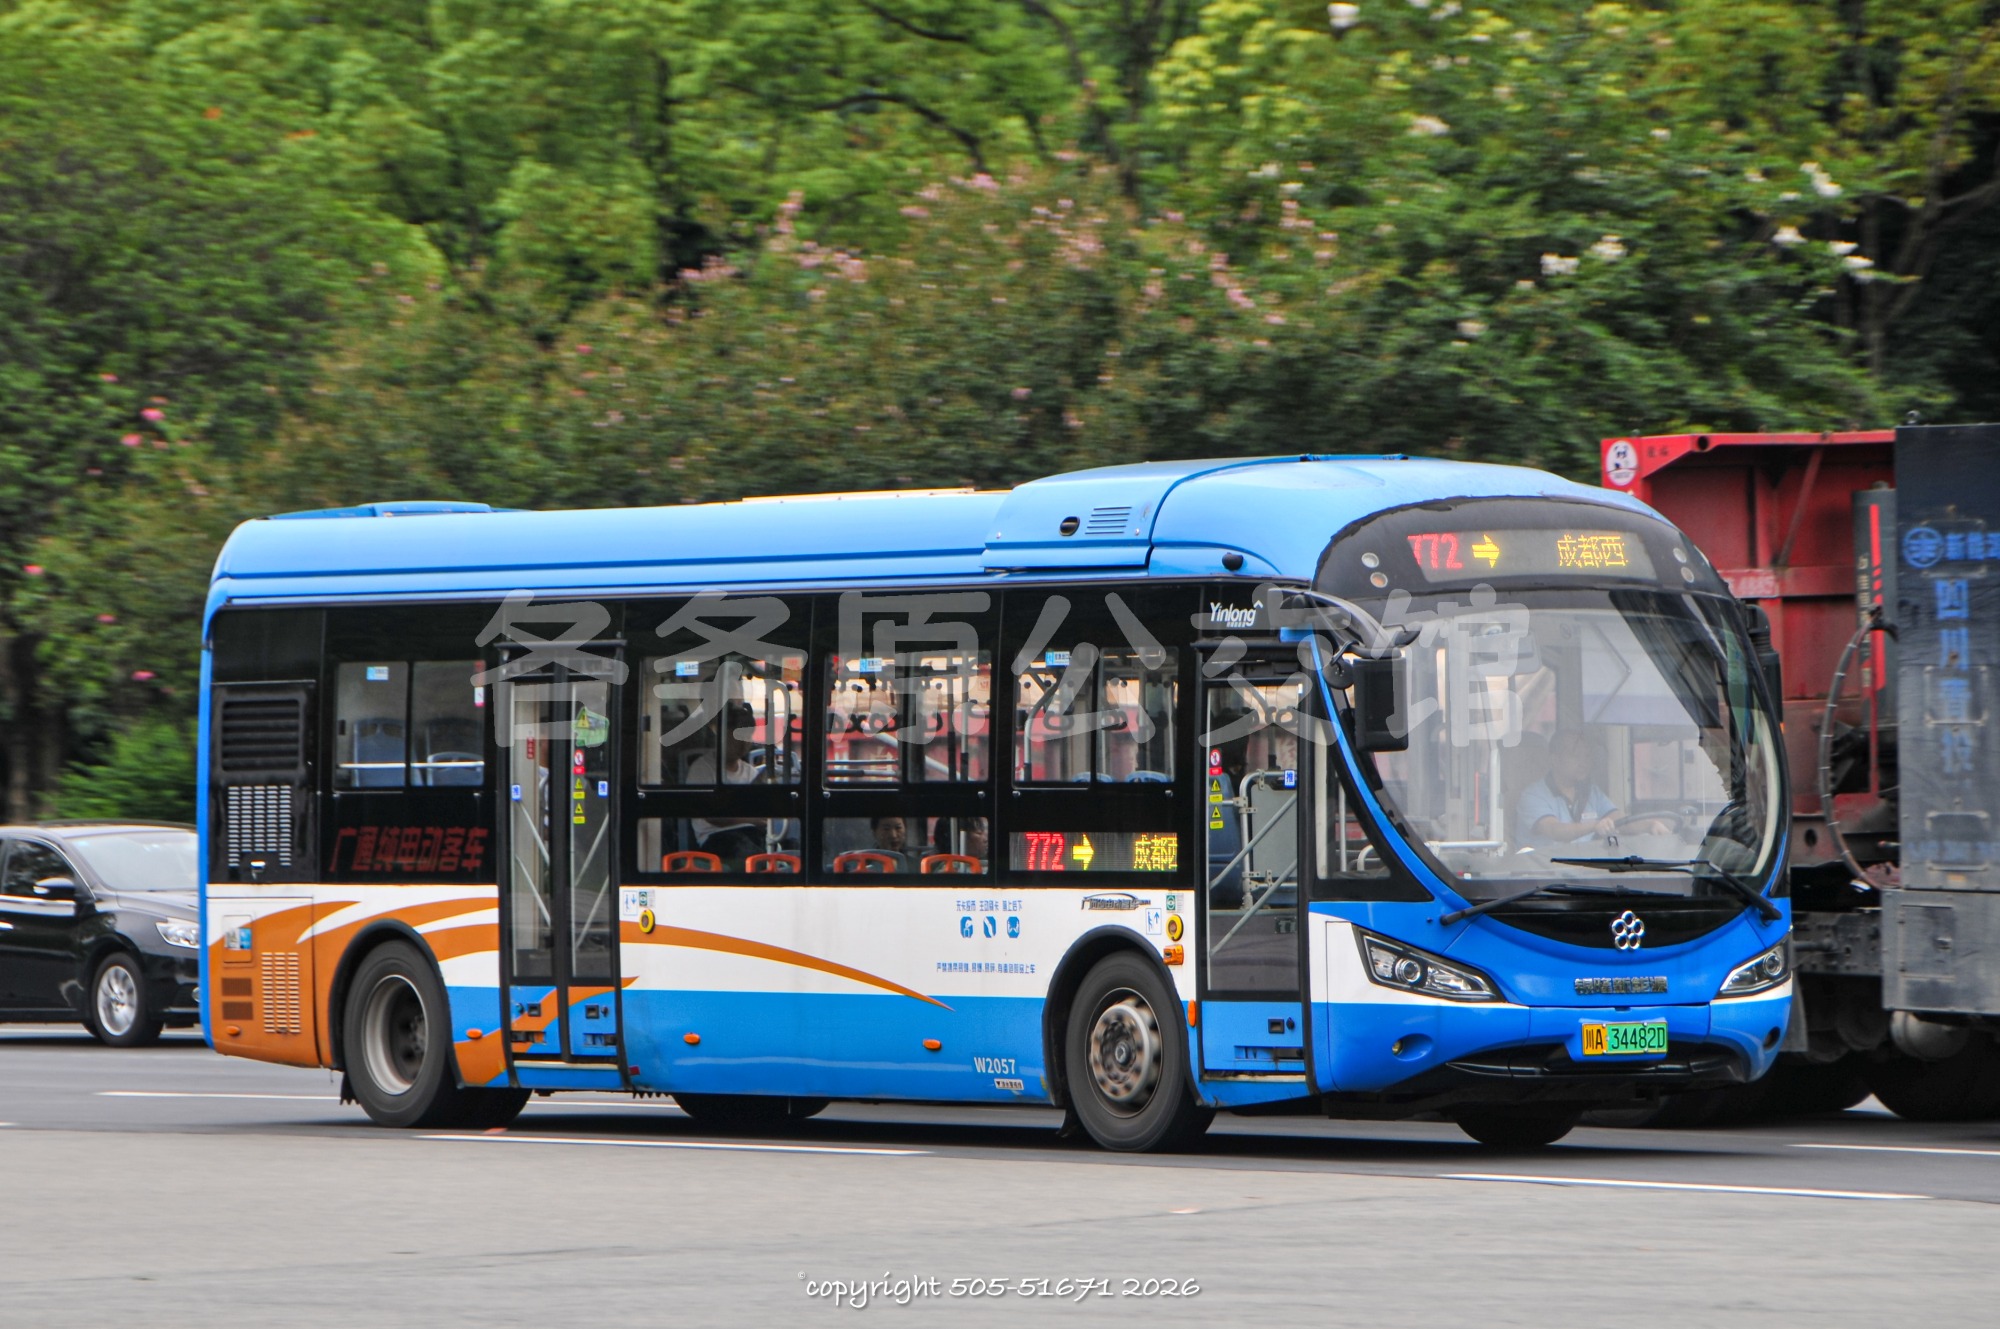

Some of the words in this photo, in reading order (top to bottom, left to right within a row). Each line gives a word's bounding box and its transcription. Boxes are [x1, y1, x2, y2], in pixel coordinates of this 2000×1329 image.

[1407, 533, 1464, 570] 772
[1557, 533, 1629, 568] 成都西
[1210, 602, 1257, 627] Yinlong
[1025, 832, 1065, 871] 772
[973, 1056, 1016, 1074] W2057
